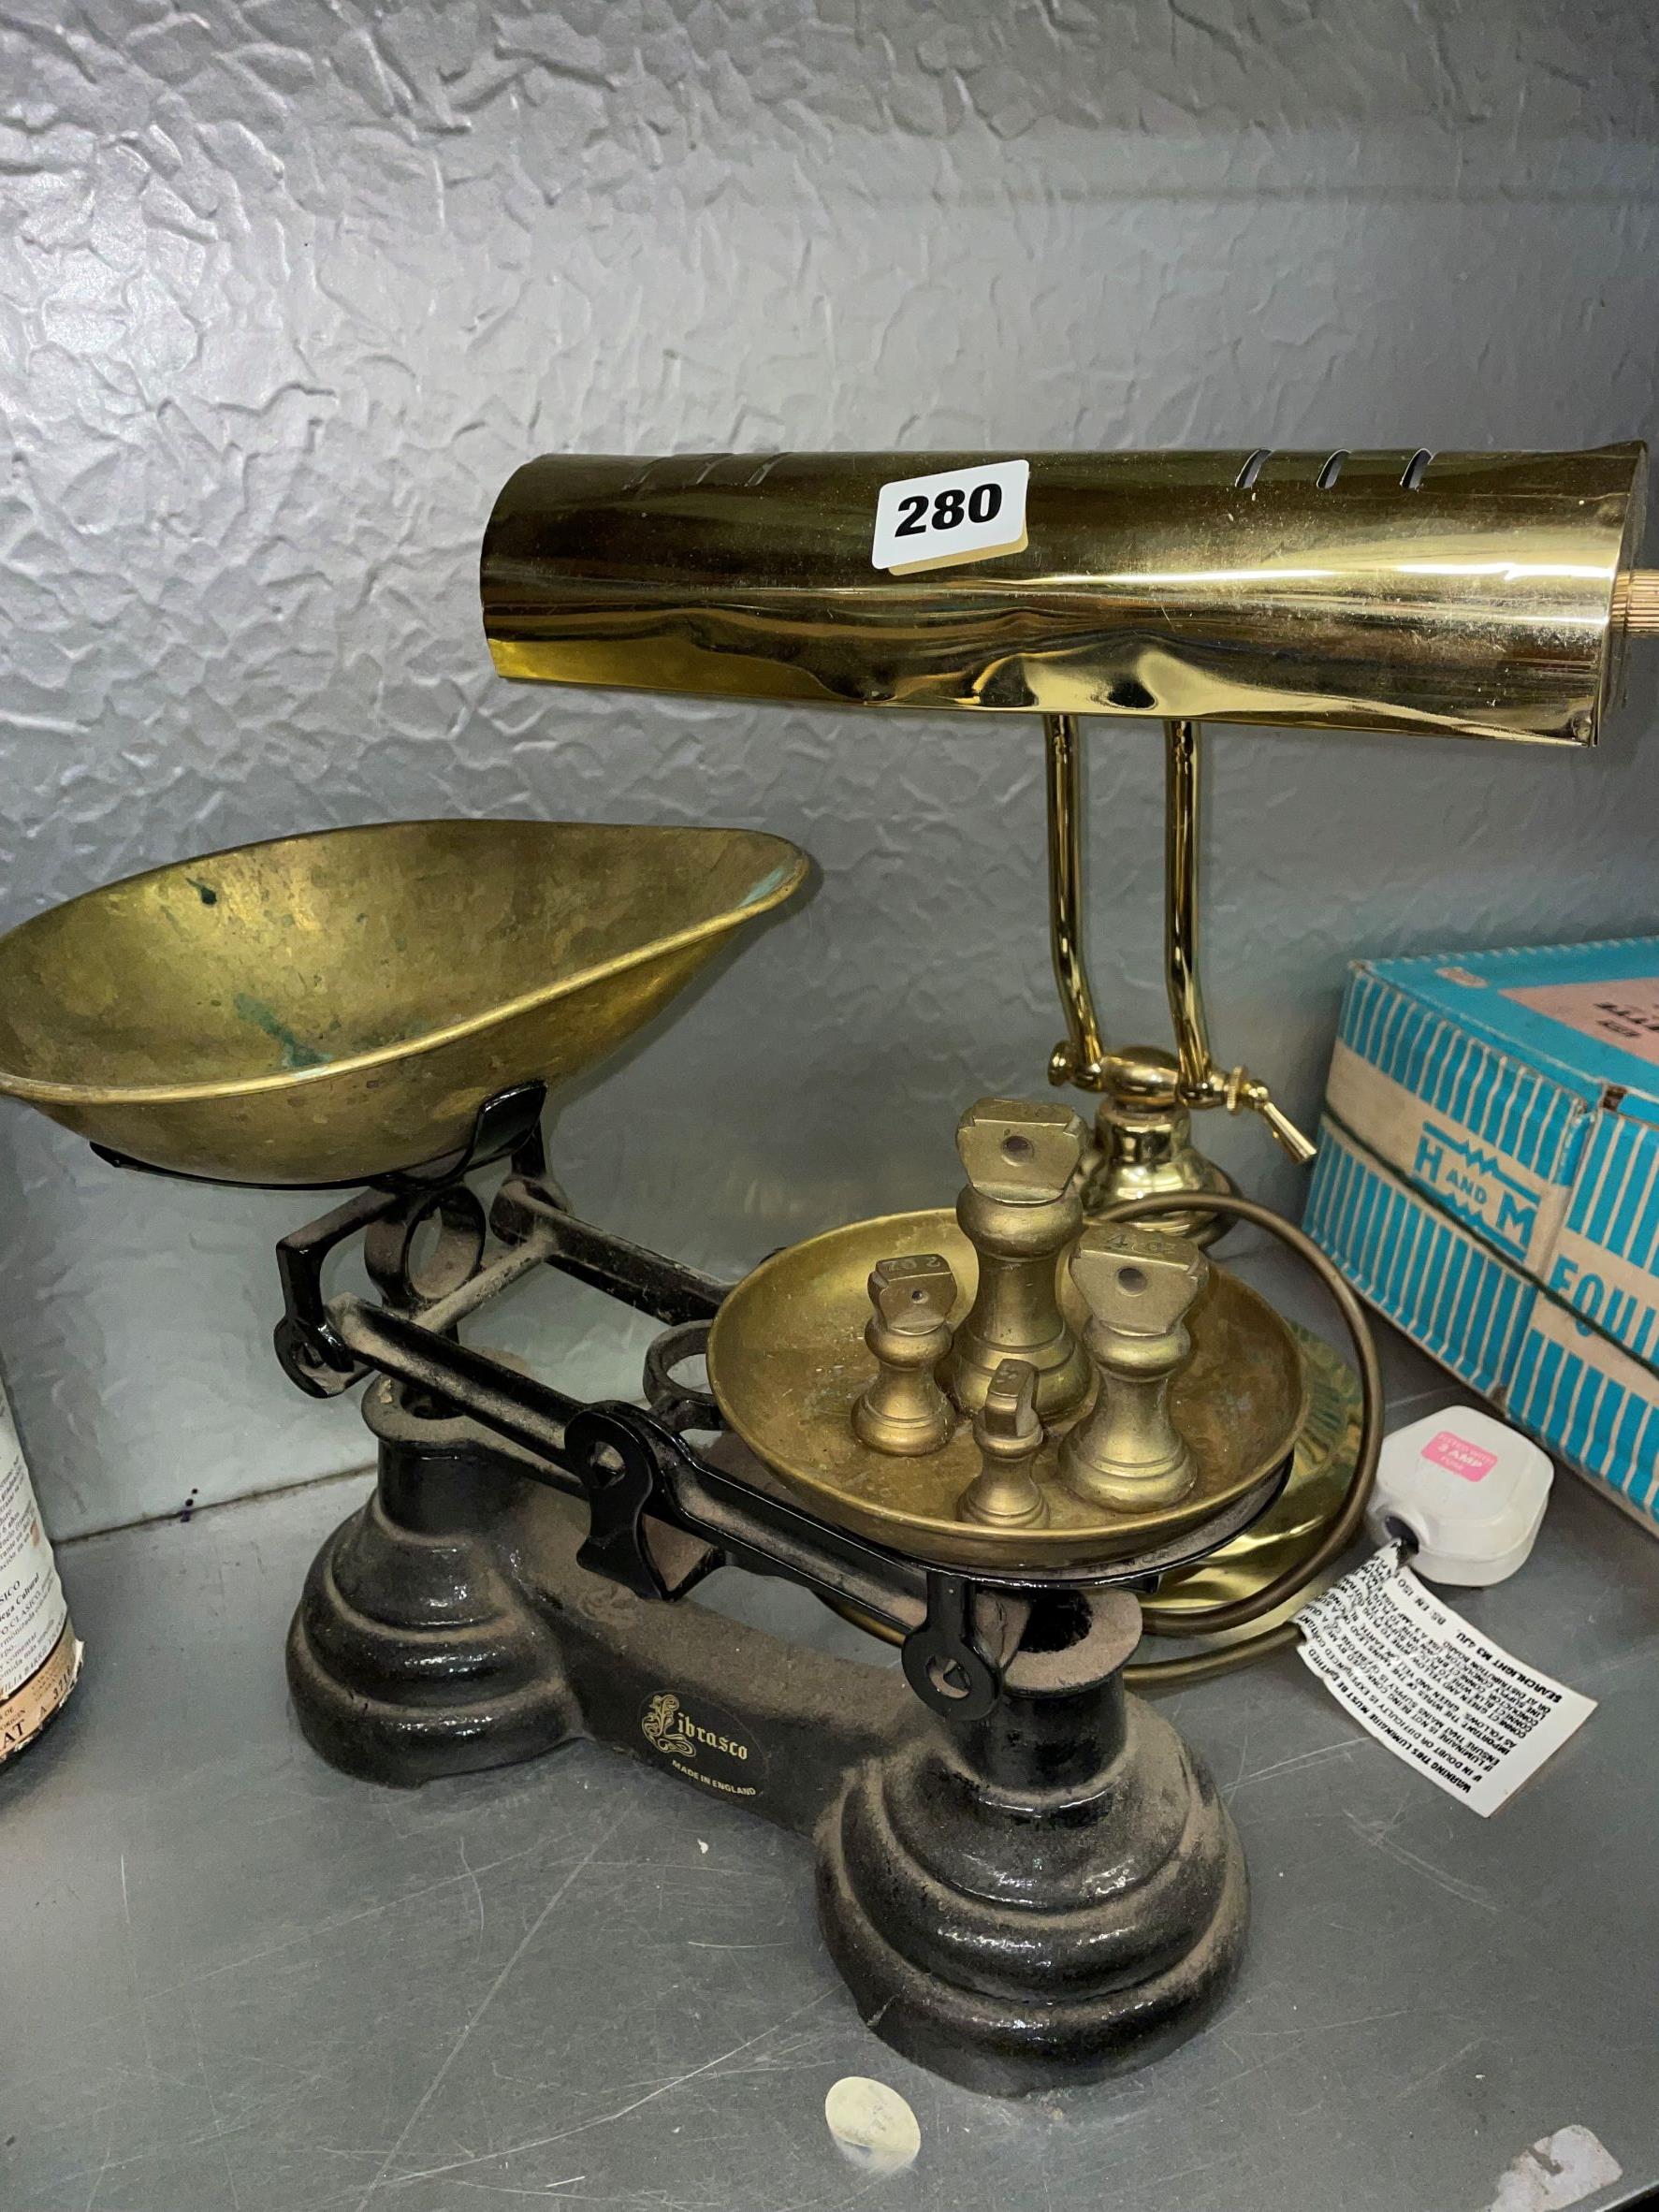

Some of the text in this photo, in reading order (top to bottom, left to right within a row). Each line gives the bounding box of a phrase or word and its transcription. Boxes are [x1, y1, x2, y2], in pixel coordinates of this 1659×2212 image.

[895, 483, 1003, 538] 280
[1414, 1136, 1537, 1250] H AND M
[1549, 1254, 1659, 1359] EQUI
[642, 1695, 749, 1760] Librasco
[672, 1760, 756, 1796] MADE IN ENGLAND
